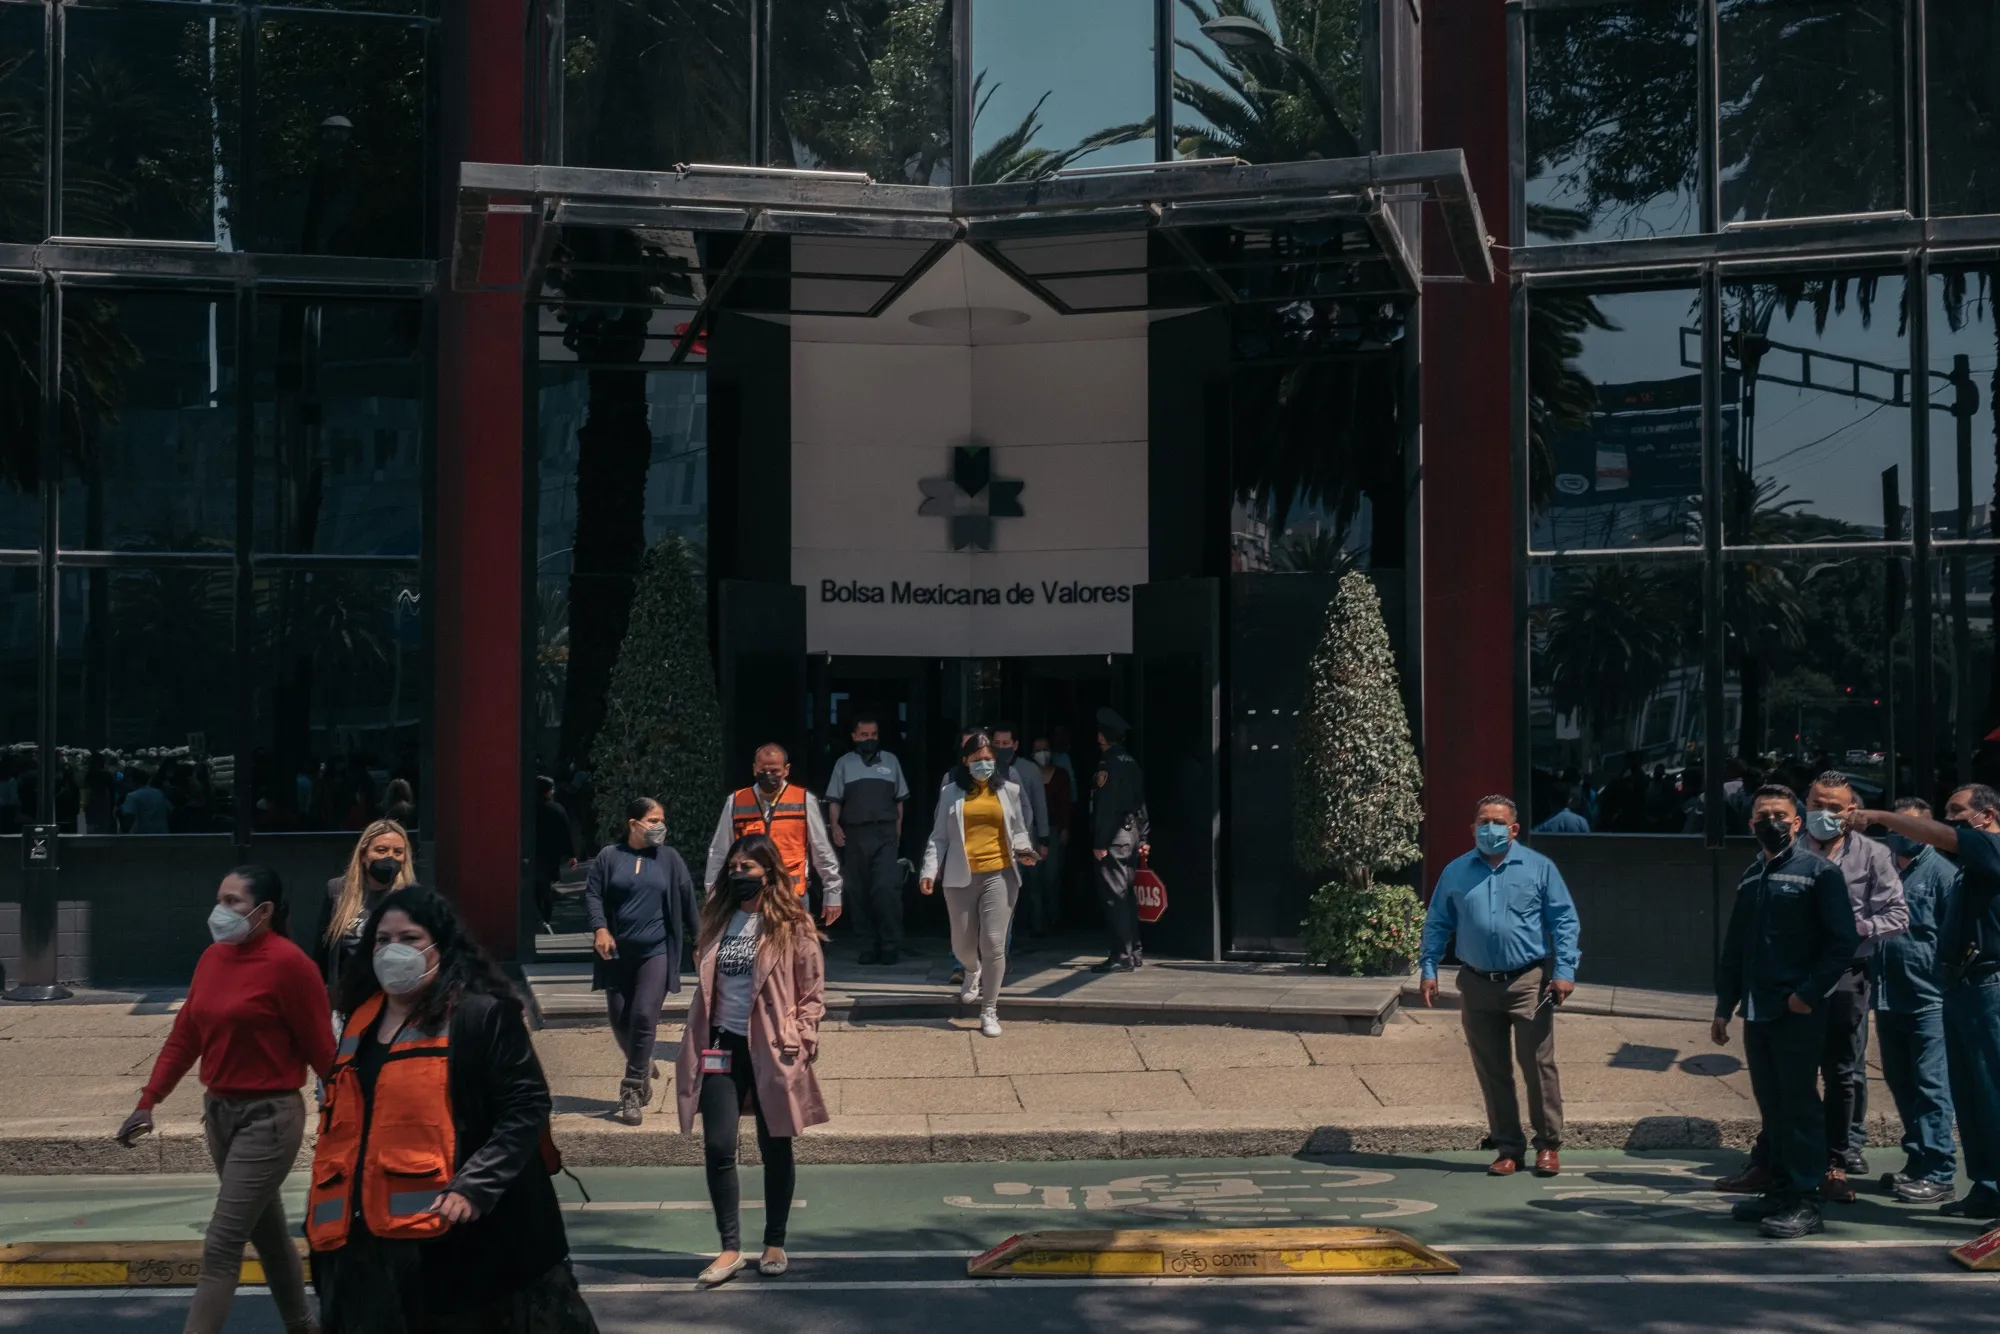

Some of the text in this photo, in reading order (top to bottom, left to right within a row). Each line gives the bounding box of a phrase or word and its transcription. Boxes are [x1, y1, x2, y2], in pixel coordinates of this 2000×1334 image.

[820, 580, 1131, 605] Bolsa Mexicana de Valores
[1133, 885, 1161, 907] STO
[1212, 1253, 1257, 1267] CDMX
